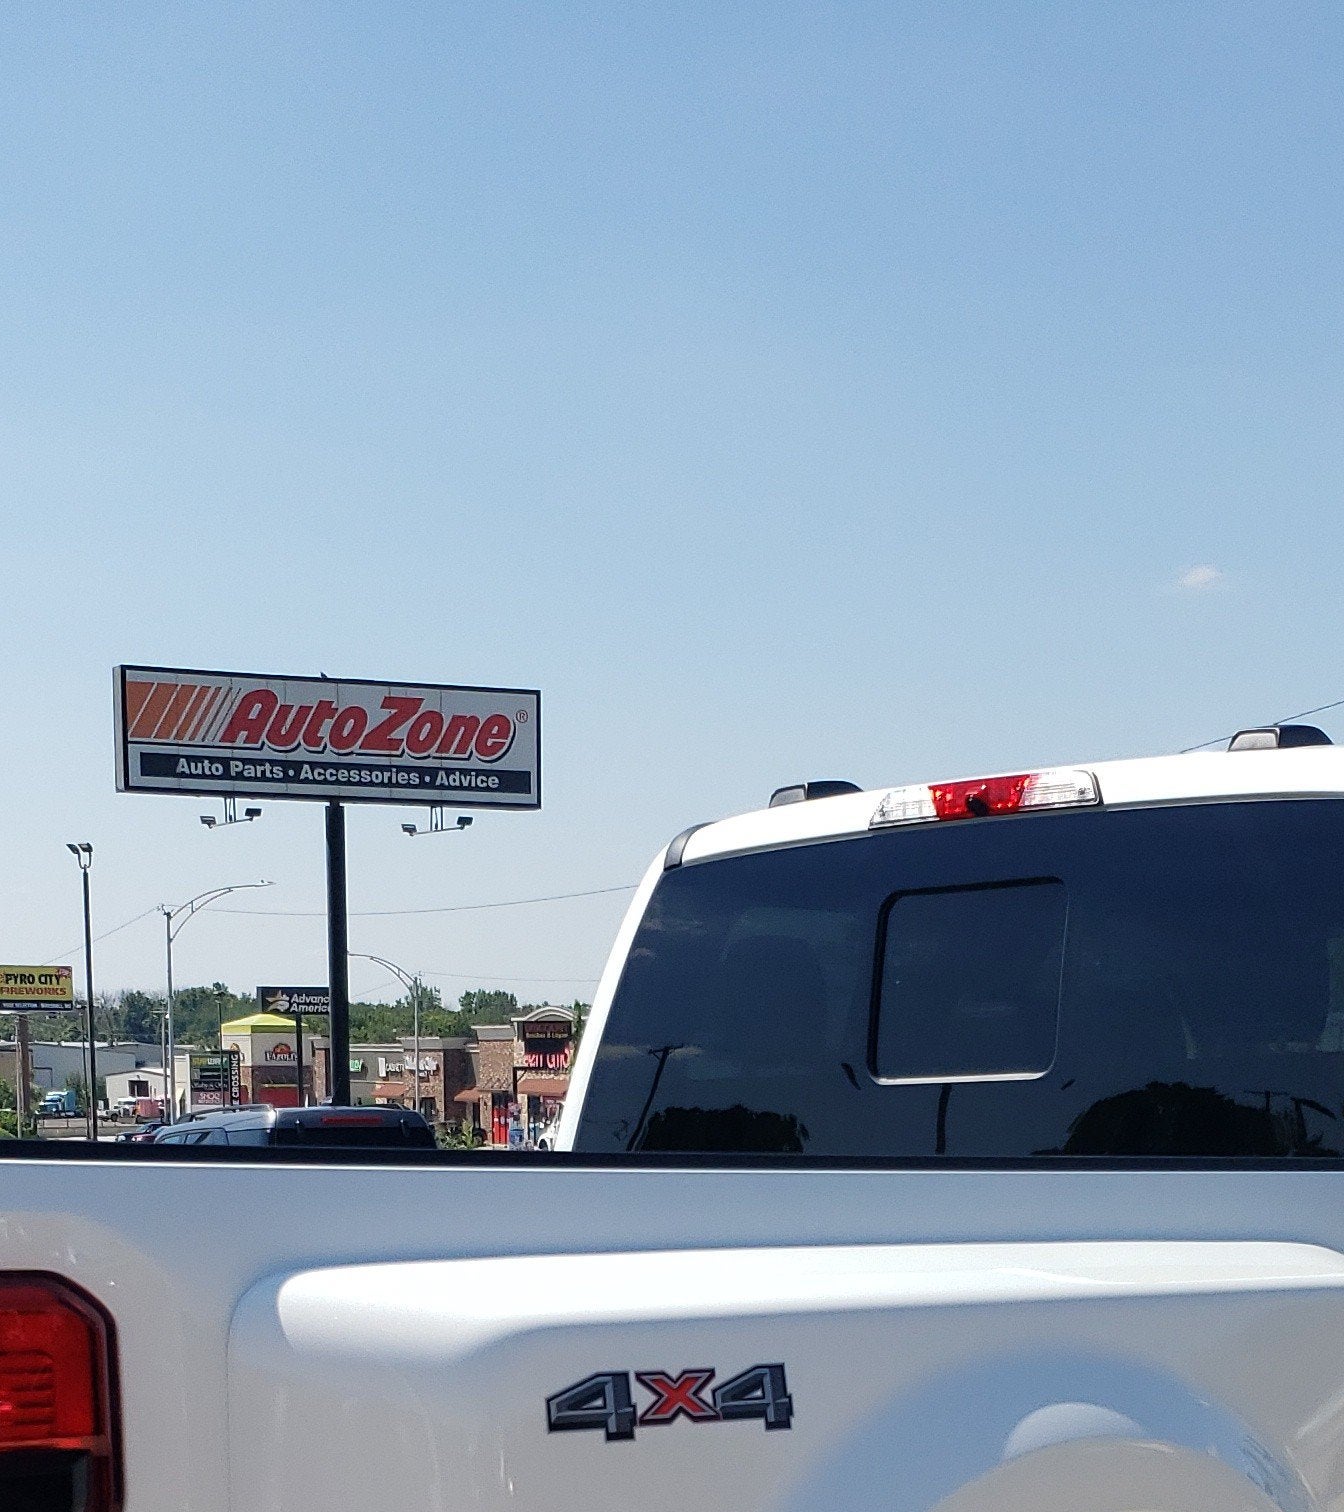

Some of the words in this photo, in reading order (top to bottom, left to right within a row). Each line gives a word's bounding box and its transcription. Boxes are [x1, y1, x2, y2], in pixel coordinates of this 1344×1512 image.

[219, 688, 515, 760] AutoZone
[176, 757, 224, 778] Auto
[230, 761, 284, 780] Parts
[300, 764, 420, 786] Accessories
[435, 770, 500, 789] Advice
[0, 986, 67, 996] FIREWORKS
[5, 973, 36, 985] PYRO
[38, 973, 62, 986] CITY
[290, 993, 330, 1004] Advanc
[230, 1054, 240, 1098] CROSSING
[546, 1362, 795, 1442] 4X4
